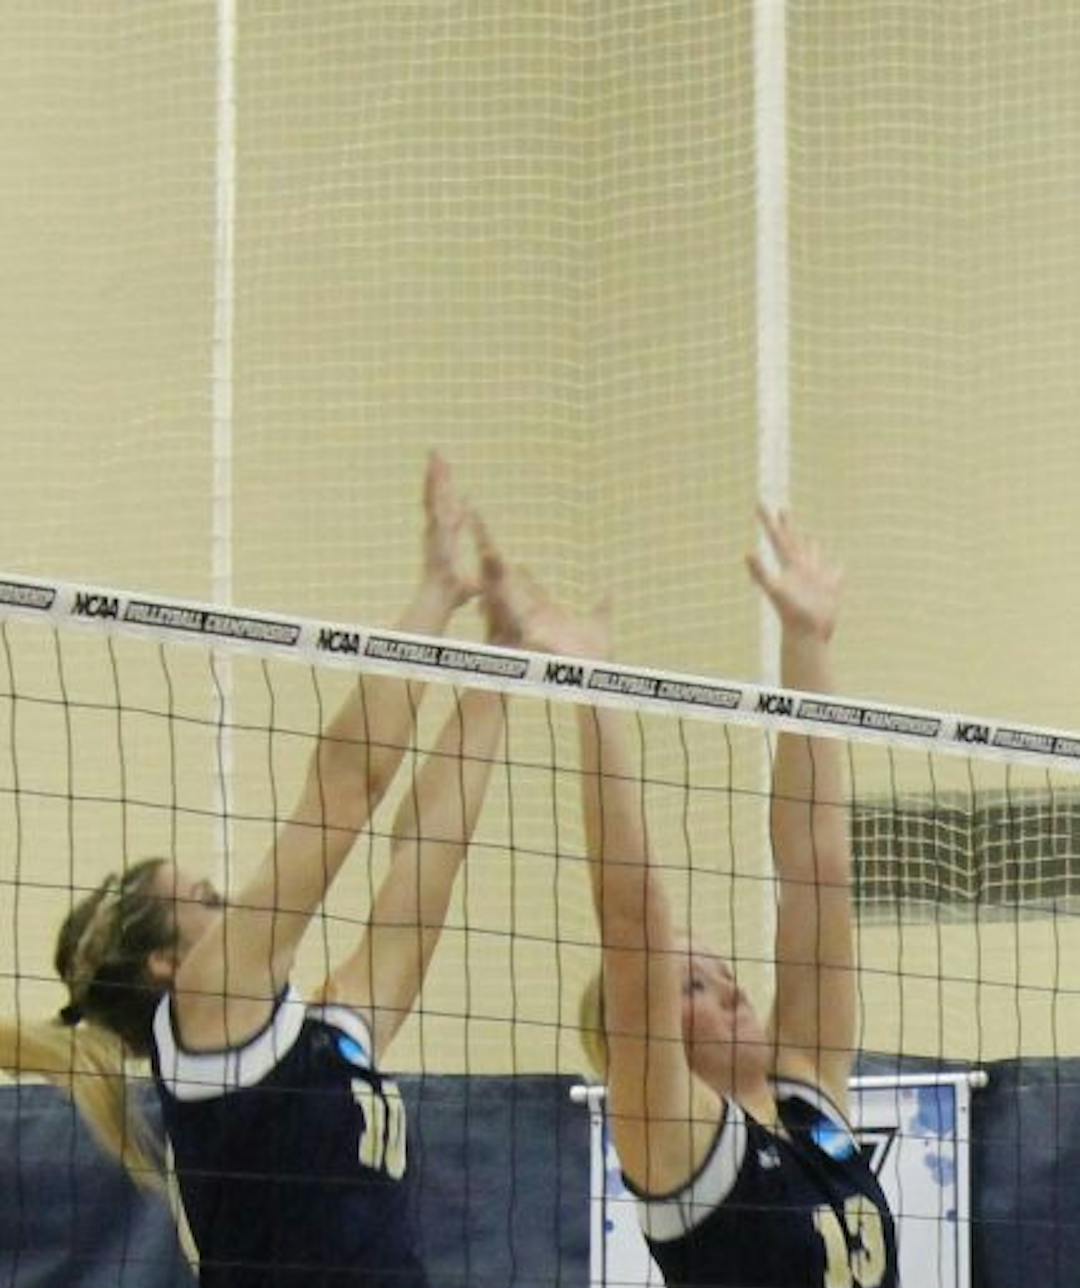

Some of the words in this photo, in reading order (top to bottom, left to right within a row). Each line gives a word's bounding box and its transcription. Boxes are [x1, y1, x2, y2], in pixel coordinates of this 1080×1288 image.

[71, 591, 118, 620] NCAA
[315, 627, 360, 655] NCAA
[543, 662, 583, 688] NCAA
[756, 693, 793, 717] NCAA
[954, 722, 989, 745] NCAA
